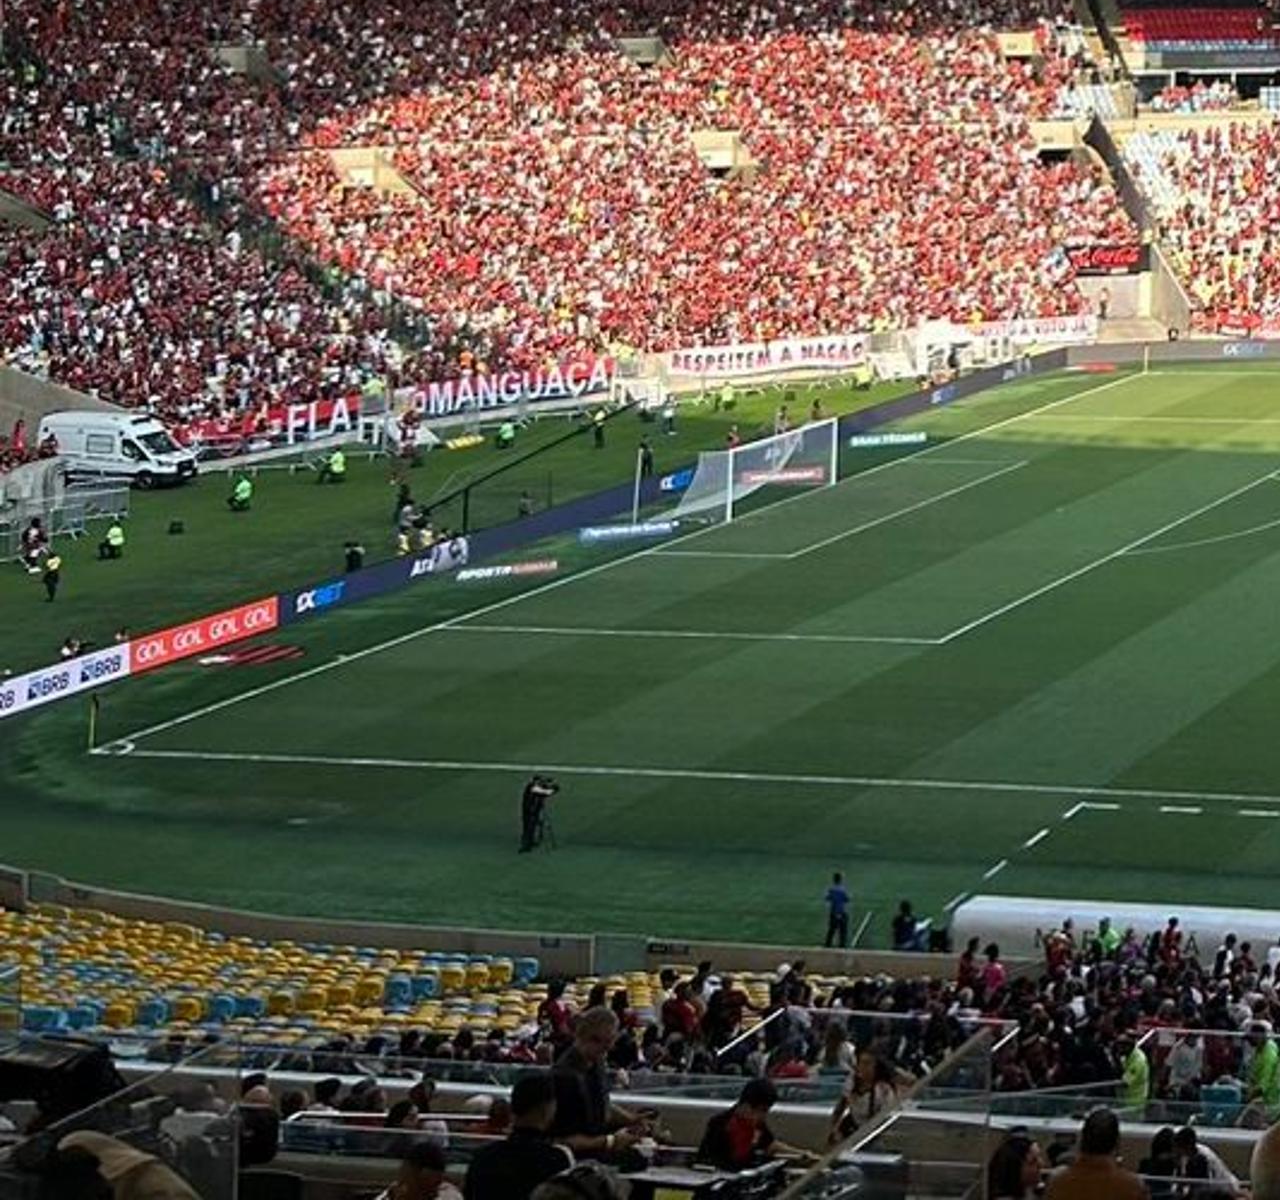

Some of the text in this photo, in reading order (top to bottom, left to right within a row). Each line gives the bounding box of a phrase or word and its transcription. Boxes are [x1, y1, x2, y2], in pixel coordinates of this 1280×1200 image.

[429, 357, 610, 414] MANGUAÇA
[671, 350, 772, 372] RESPEITEM
[780, 347, 793, 362] A
[287, 398, 351, 445] FLA
[136, 605, 273, 665] GOL GOL GOL GOL
